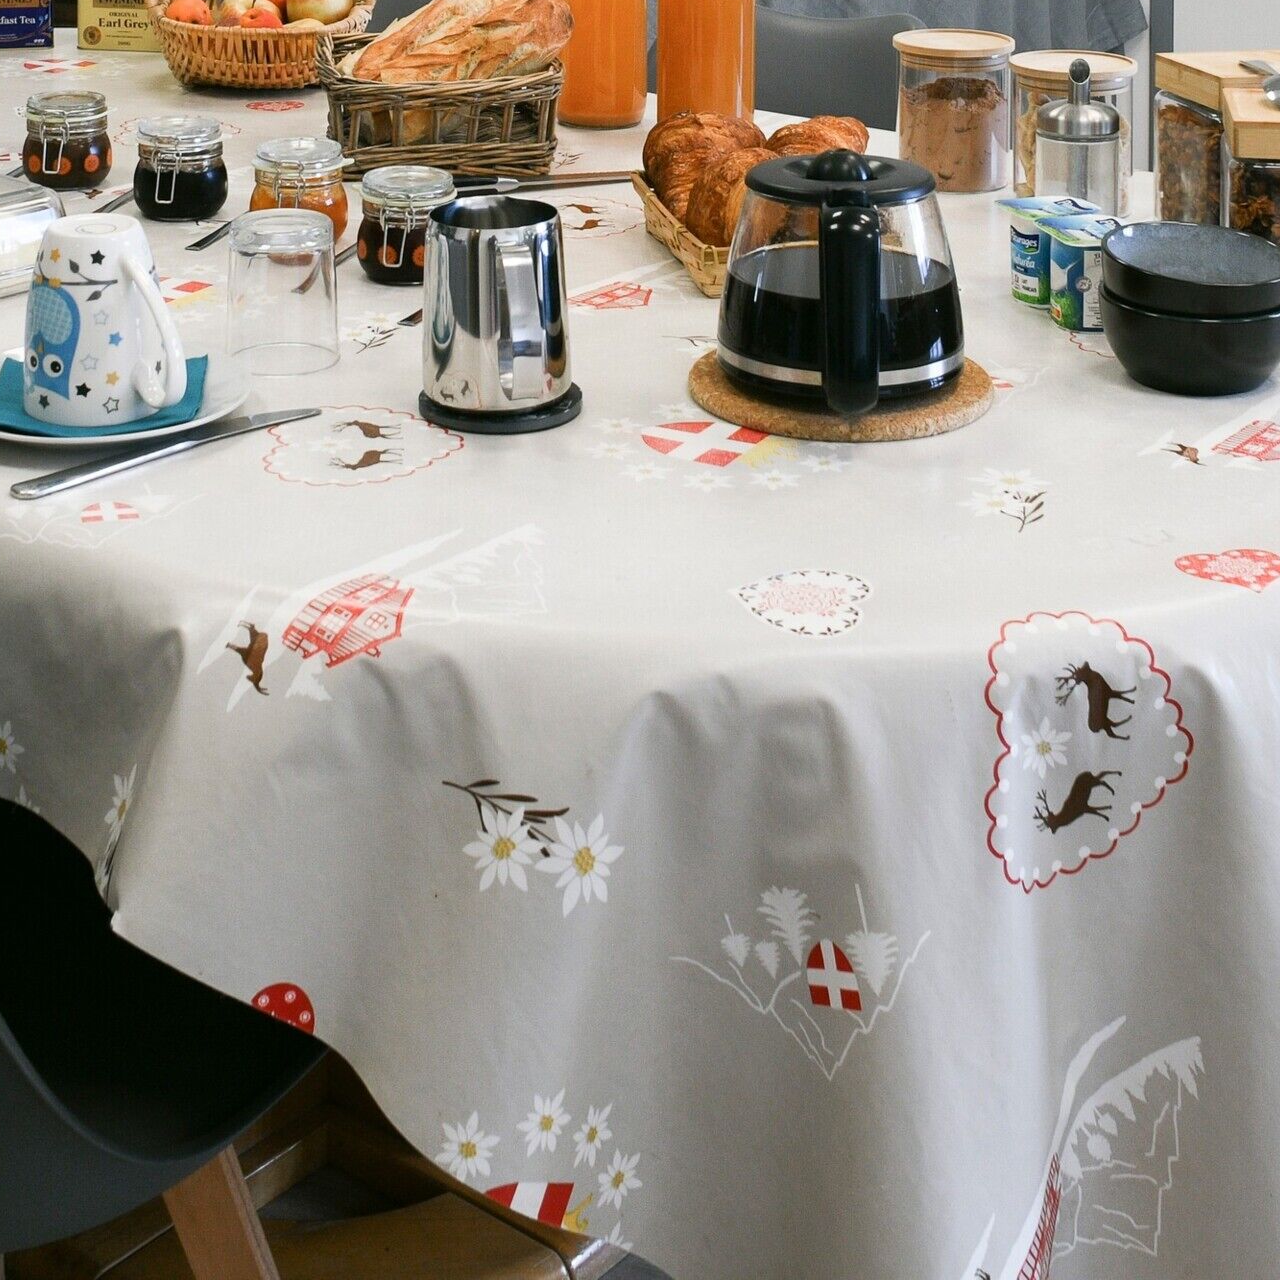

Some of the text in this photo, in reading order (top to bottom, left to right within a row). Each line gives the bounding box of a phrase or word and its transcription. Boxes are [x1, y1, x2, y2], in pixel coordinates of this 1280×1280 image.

[19, 15, 36, 24] Tea
[98, 18, 150, 30] Earl Grey
